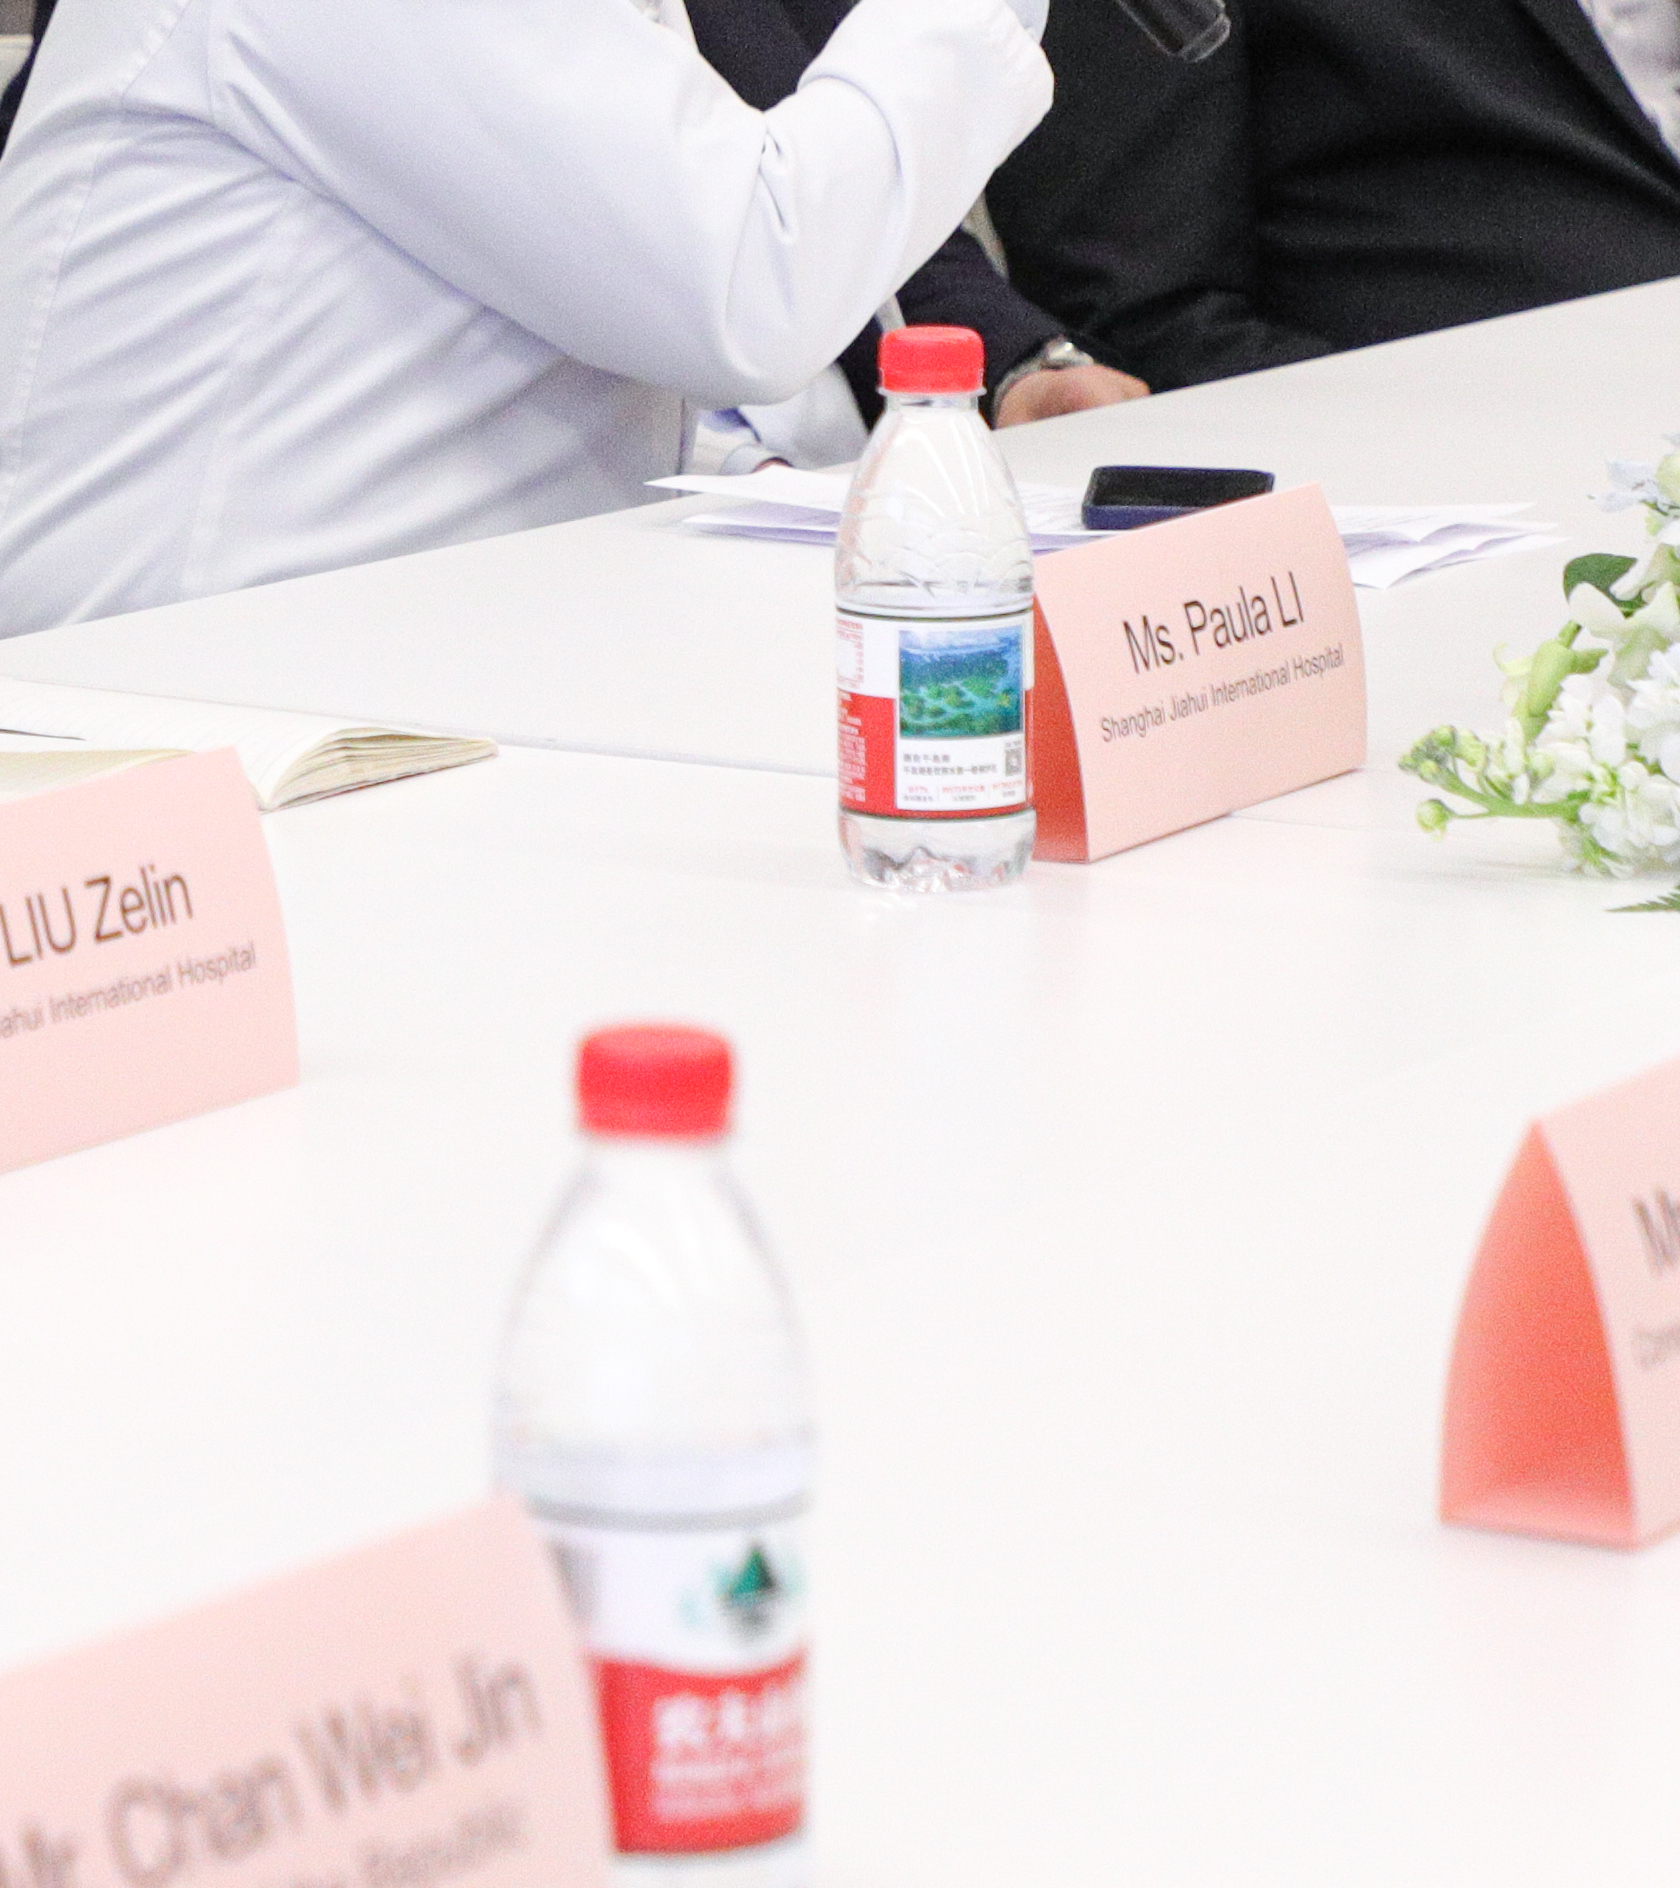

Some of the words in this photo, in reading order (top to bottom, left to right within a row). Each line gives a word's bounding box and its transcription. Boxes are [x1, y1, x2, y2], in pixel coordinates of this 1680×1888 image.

[1123, 615, 1184, 675] Ms.
[1184, 585, 1273, 655] Paula
[1271, 571, 1305, 629] LI
[1101, 701, 1167, 743] Shanghai
[1170, 689, 1209, 721] Jiahui
[1211, 662, 1291, 706] International
[1293, 642, 1344, 681] Hospital
[84, 864, 194, 944] Zelin
[50, 964, 172, 1024] International
[177, 940, 257, 987] Hospital
[104, 1753, 306, 1888] Chan
[293, 1670, 442, 1814] Wei
[452, 1648, 546, 1769] Jin
